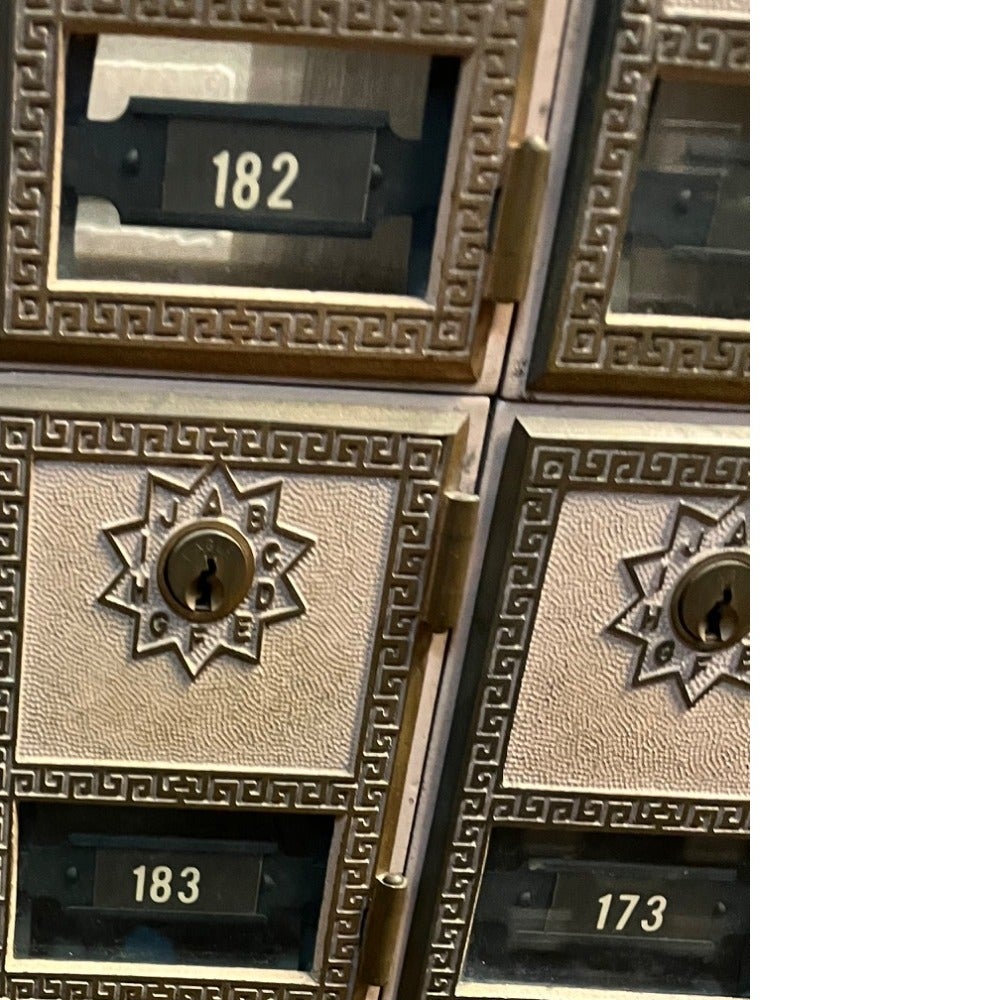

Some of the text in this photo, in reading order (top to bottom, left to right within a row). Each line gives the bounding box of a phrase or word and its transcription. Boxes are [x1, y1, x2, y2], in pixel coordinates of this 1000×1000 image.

[212, 150, 299, 210] 182
[159, 497, 179, 529] J
[202, 486, 224, 517] A
[248, 502, 267, 533] B
[262, 542, 282, 570] C
[131, 569, 149, 603] H
[256, 579, 275, 610] D
[150, 611, 169, 637] G
[189, 625, 208, 650] F
[235, 611, 253, 643] E
[133, 865, 201, 904] 183
[596, 893, 667, 932] 173
